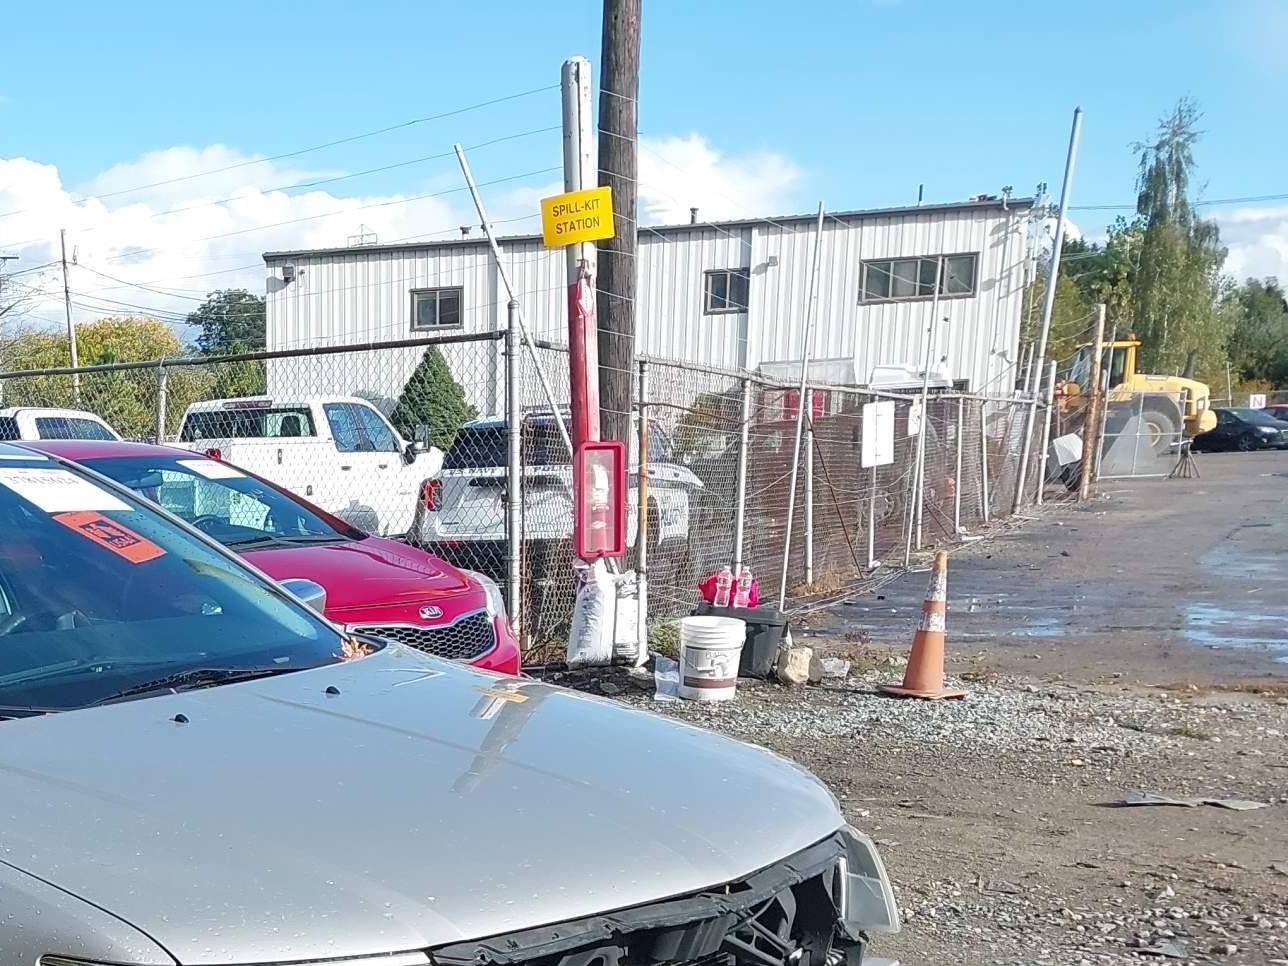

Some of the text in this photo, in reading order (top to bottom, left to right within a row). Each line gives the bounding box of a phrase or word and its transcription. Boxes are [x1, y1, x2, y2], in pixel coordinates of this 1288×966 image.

[552, 198, 600, 217] SPILL-KIT
[555, 216, 600, 234] STATION
[420, 606, 443, 618] KIA
